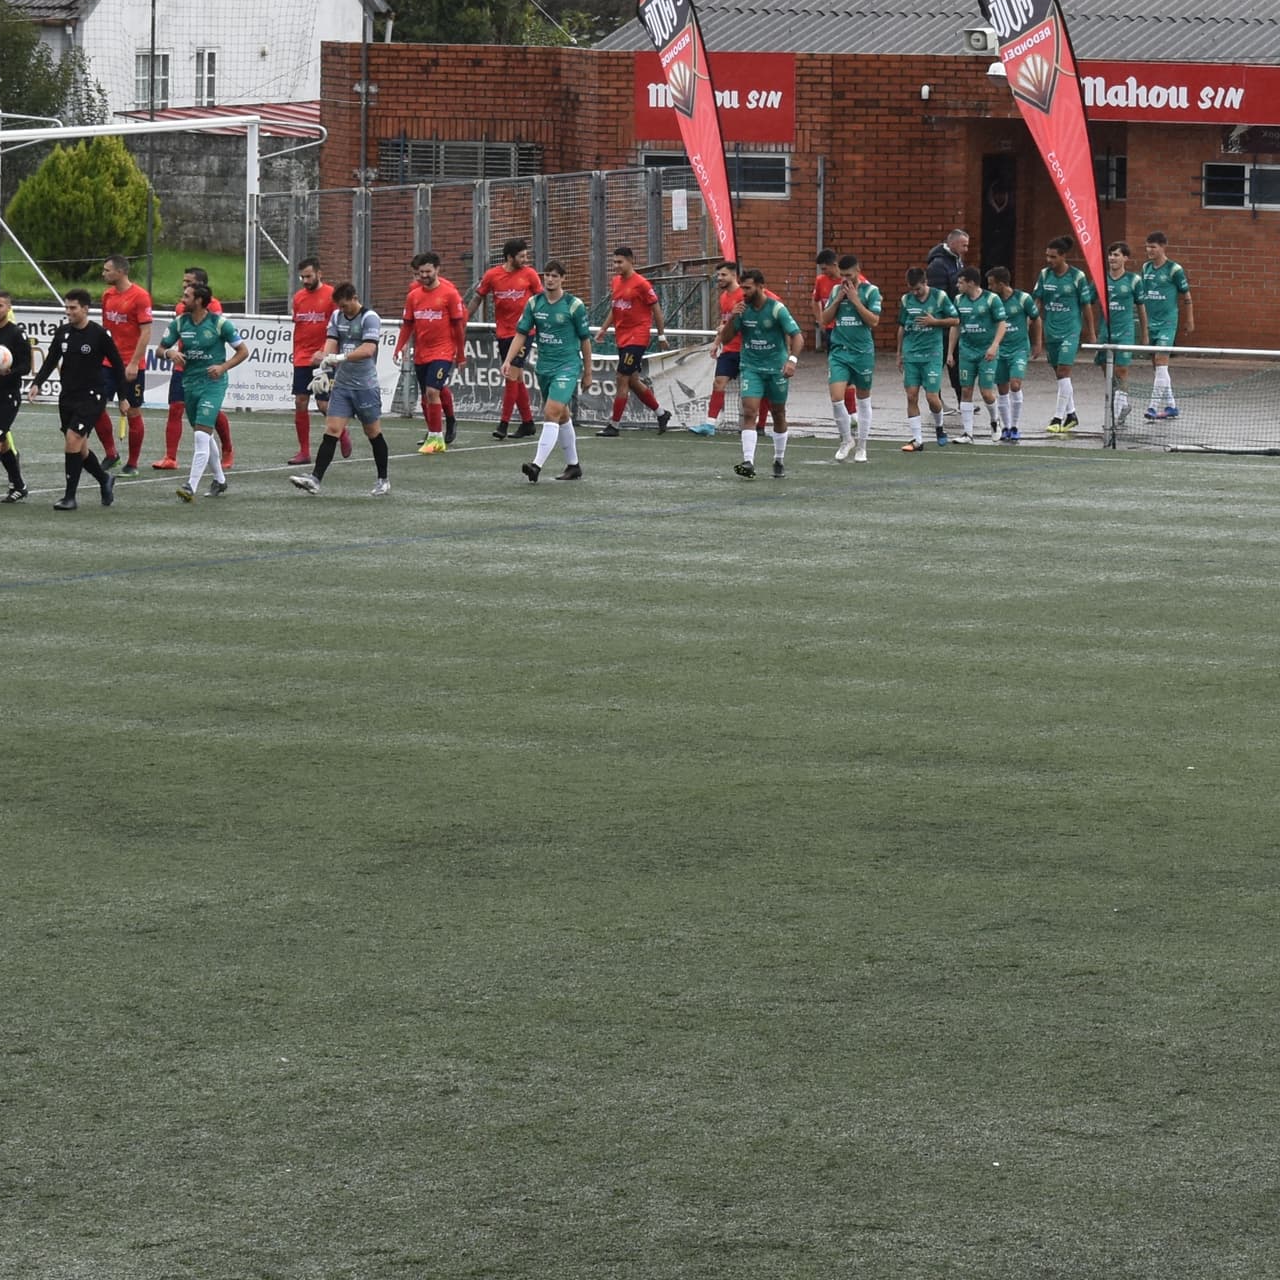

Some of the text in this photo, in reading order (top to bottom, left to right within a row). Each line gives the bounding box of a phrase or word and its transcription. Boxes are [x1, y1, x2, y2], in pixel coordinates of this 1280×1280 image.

[746, 90, 783, 109] SIN
[1080, 75, 1245, 110] Mahou SIN
[233, 325, 292, 345] cología
[248, 347, 294, 364] Alime
[623, 353, 634, 366] 16
[436, 369, 443, 379] 6
[444, 368, 505, 387] ALEG
[134, 384, 141, 397] 5
